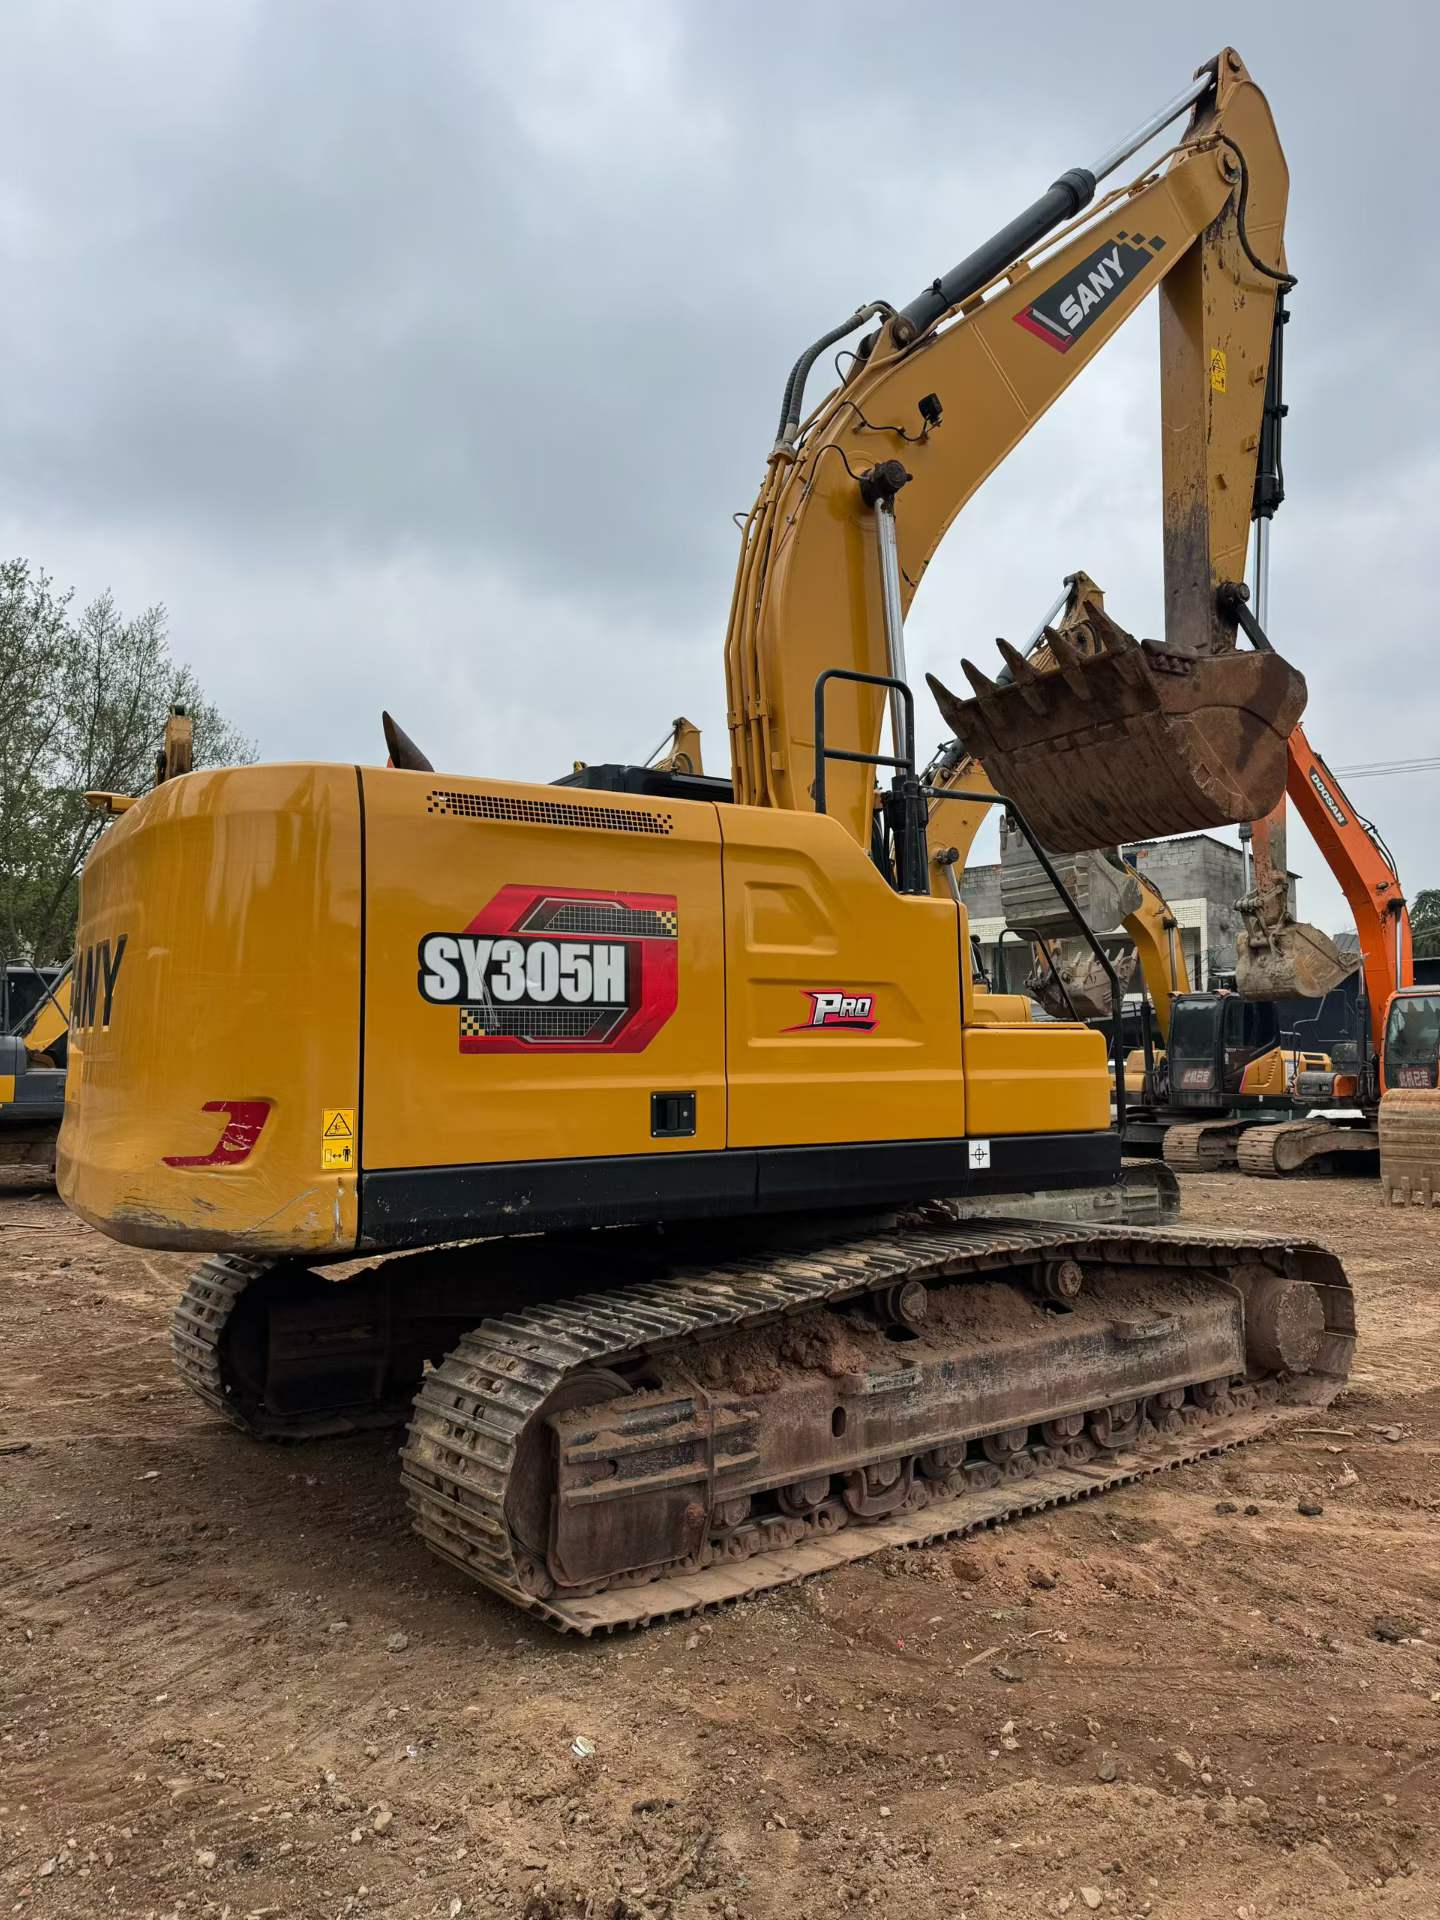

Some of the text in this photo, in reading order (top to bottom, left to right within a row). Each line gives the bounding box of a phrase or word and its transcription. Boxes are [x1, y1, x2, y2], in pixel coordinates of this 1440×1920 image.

[1059, 246, 1125, 330] SANY
[1311, 773, 1345, 824] DOOSAN
[423, 936, 626, 1003] SY305H
